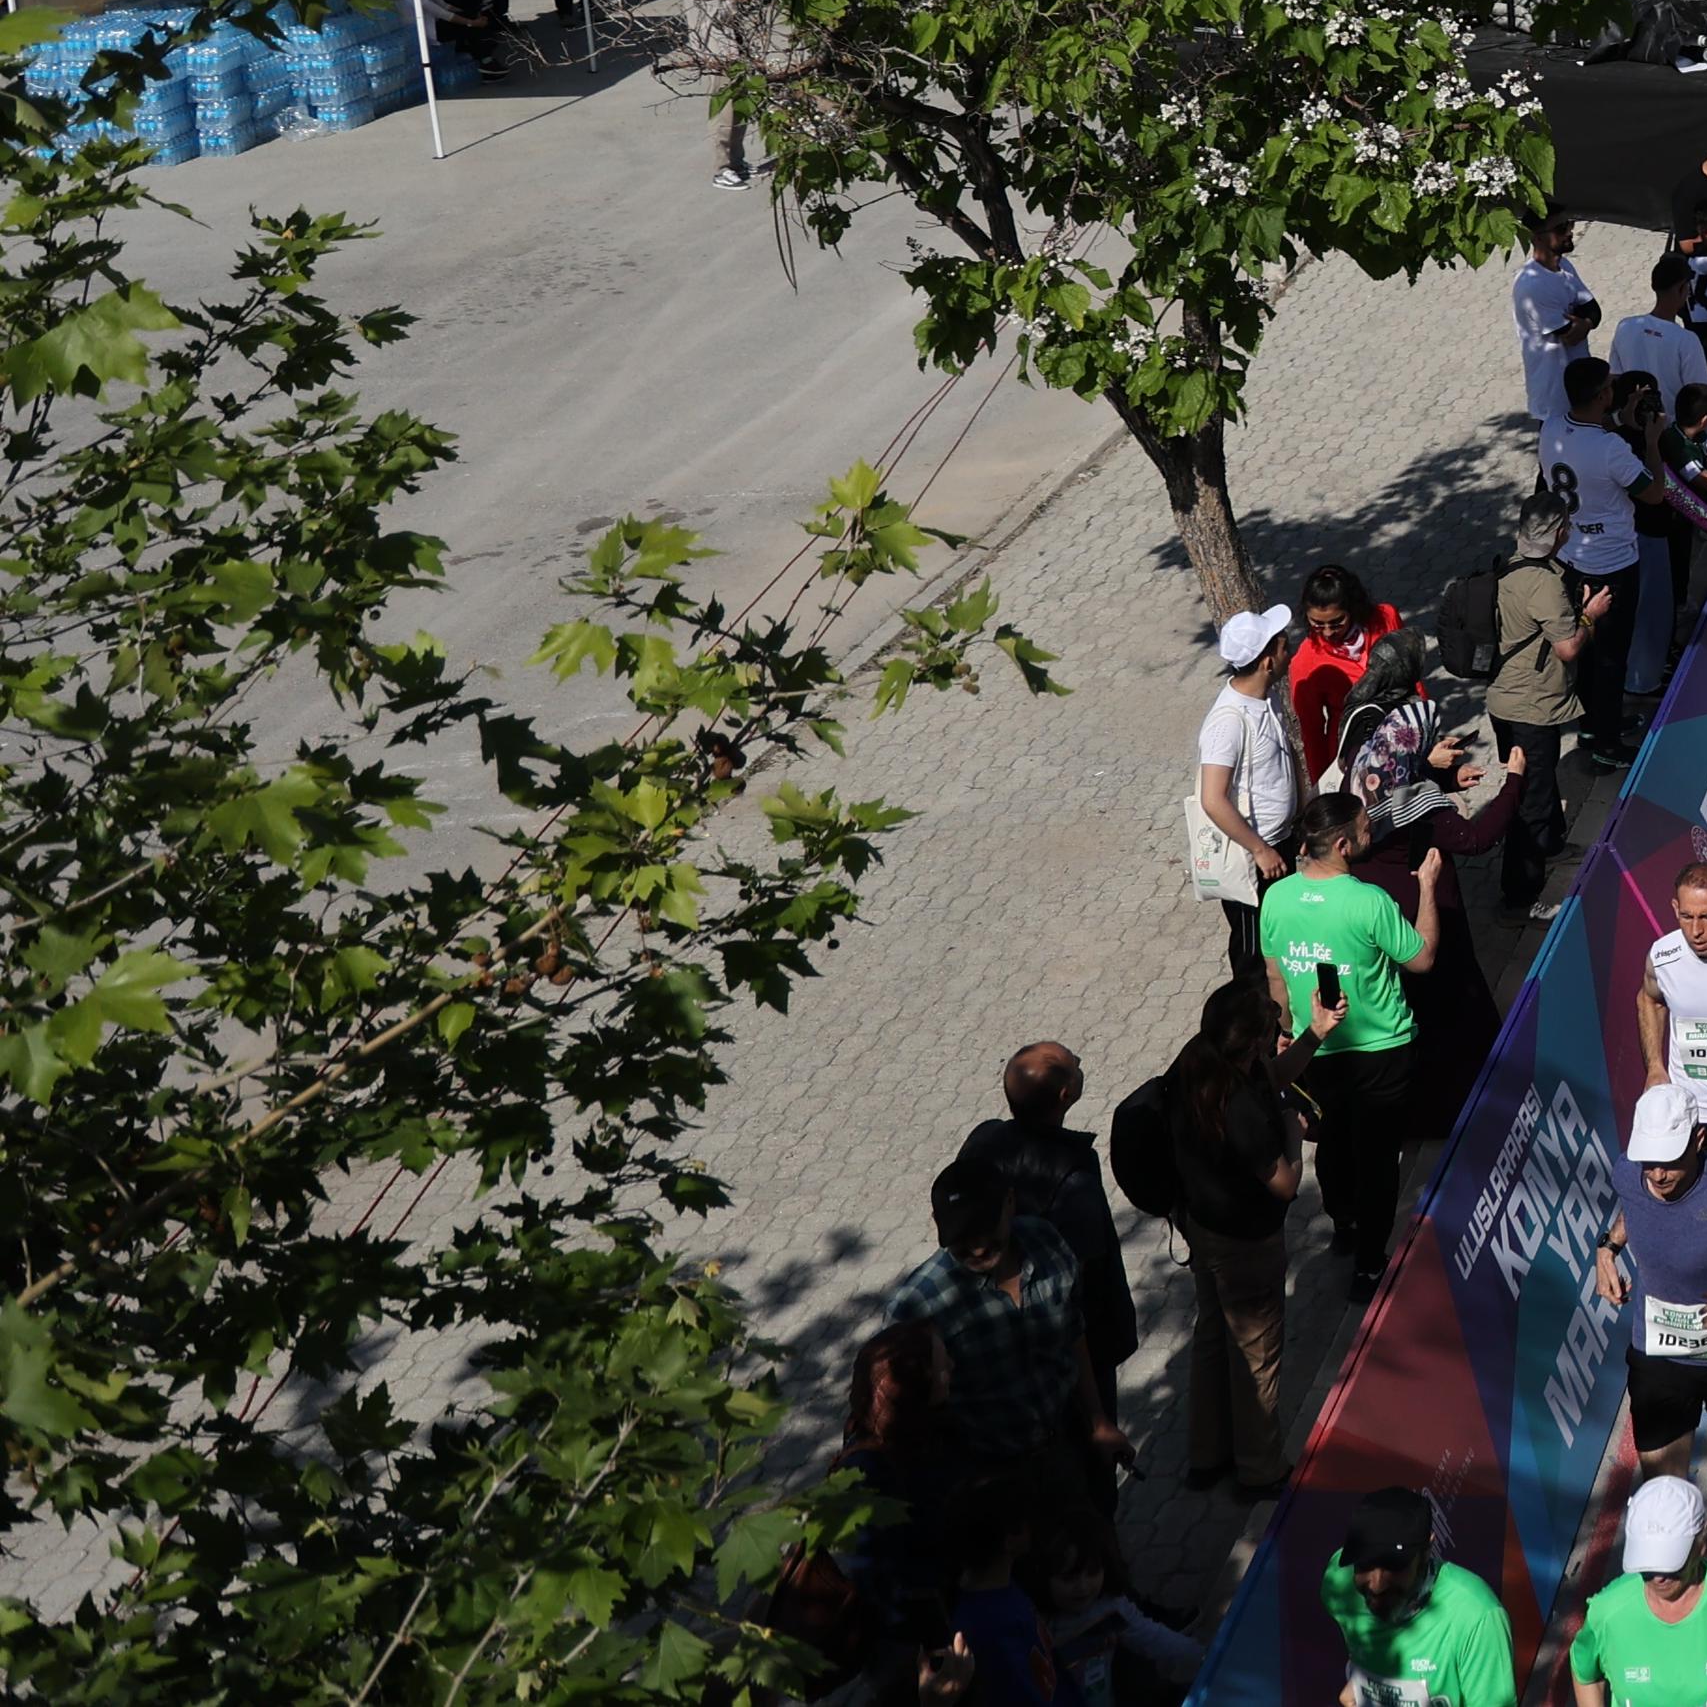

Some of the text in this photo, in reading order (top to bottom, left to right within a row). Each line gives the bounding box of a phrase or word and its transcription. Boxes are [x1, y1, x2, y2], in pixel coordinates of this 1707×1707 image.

[1454, 1081, 1543, 1282] ULUSLARARASI
[1489, 1079, 1590, 1302] KONYA
[1546, 1127, 1618, 1279] YARI
[1654, 1316, 1703, 1331] MARATON
